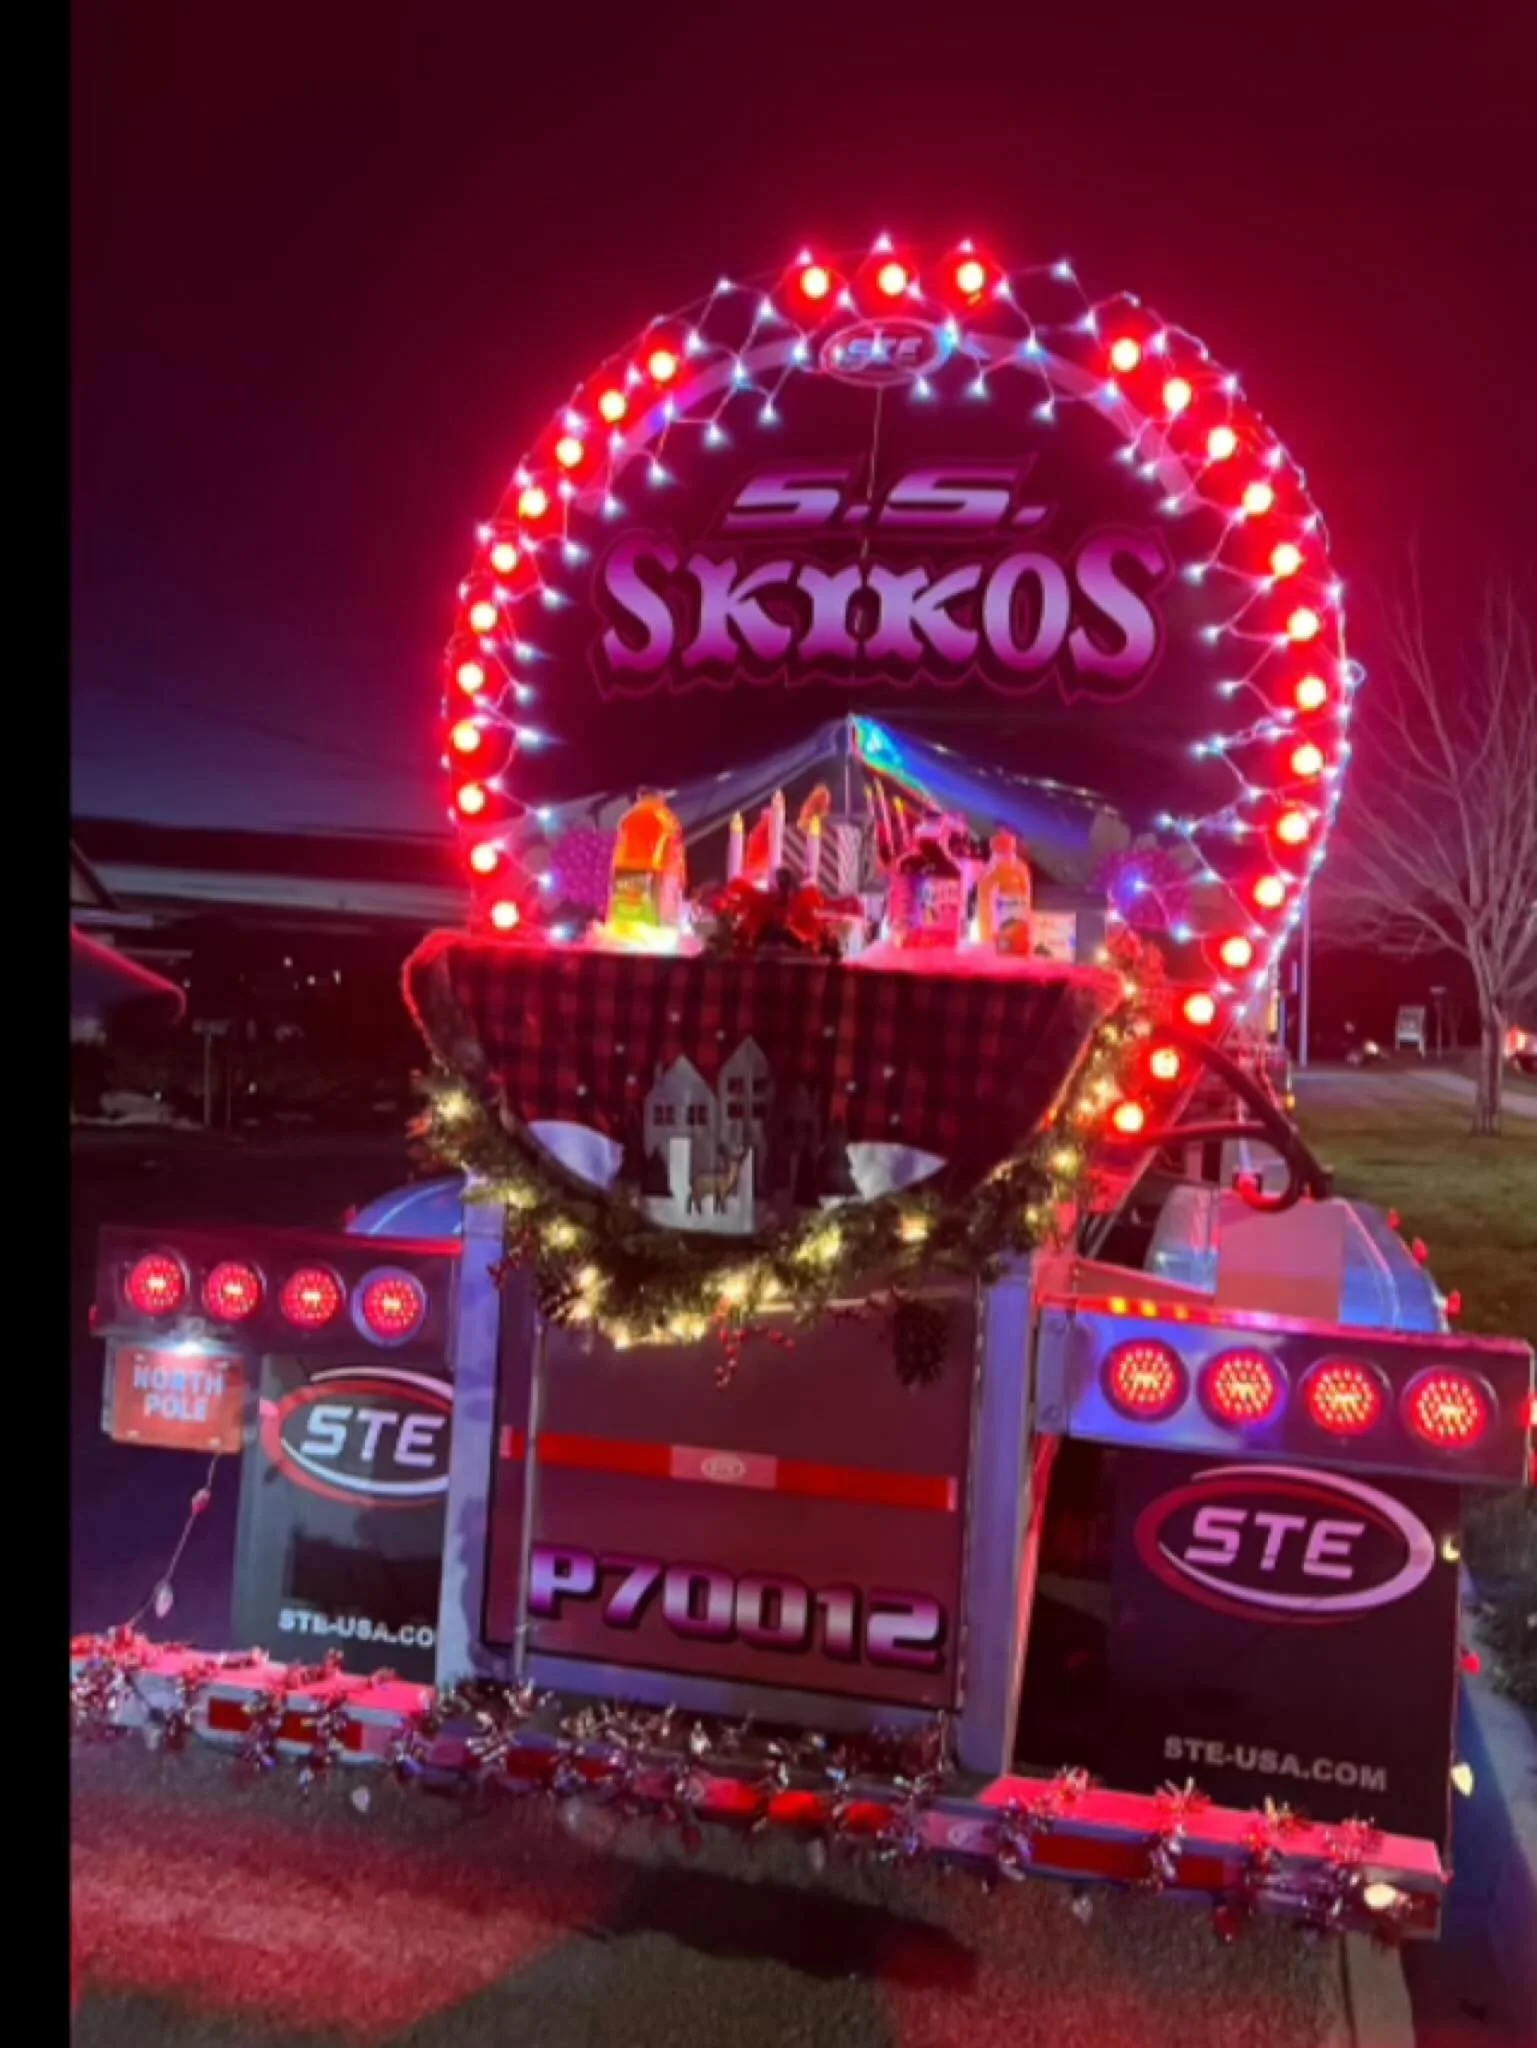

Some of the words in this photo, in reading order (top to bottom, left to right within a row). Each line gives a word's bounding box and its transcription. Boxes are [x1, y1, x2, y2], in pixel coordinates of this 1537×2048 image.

[722, 467, 1047, 530] S.S.
[602, 536, 1168, 678] SKIKOS
[133, 1364, 225, 1397] NORTH
[144, 1393, 207, 1423] POLE
[299, 1404, 448, 1468] STE
[1184, 1504, 1365, 1581] STE
[277, 1608, 434, 1648] STE-USA.CO
[527, 1545, 945, 1670] P70012
[1163, 1735, 1387, 1793] STE-USA.COM
